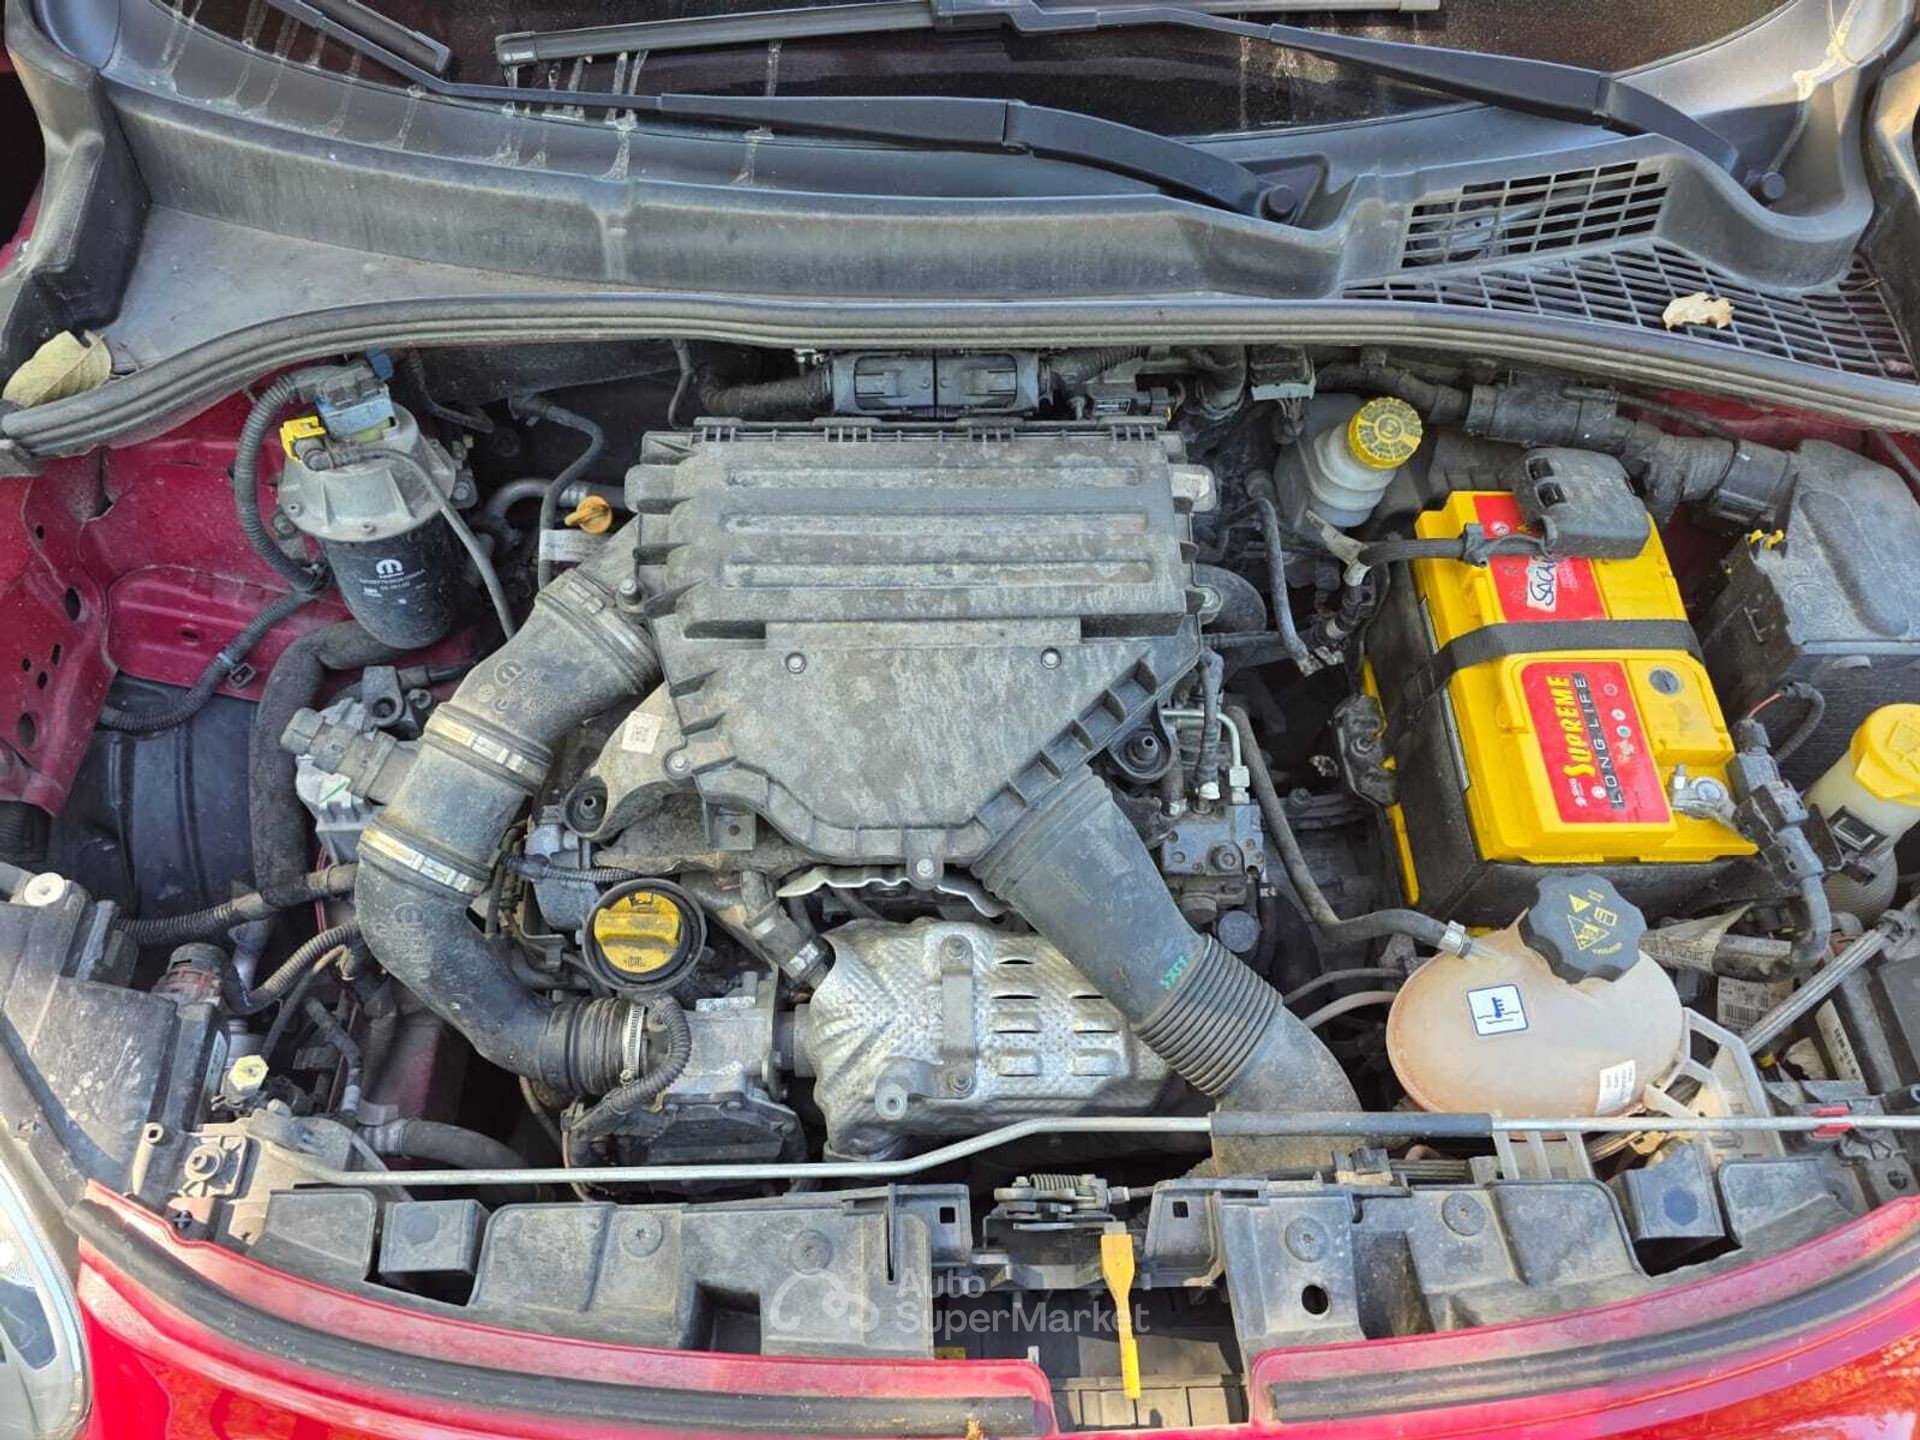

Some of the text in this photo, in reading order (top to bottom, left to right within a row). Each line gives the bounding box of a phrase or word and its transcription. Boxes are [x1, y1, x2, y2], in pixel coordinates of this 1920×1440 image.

[1545, 676, 1596, 777] SUPREME
[1574, 678, 1623, 804] LONG LIFE
